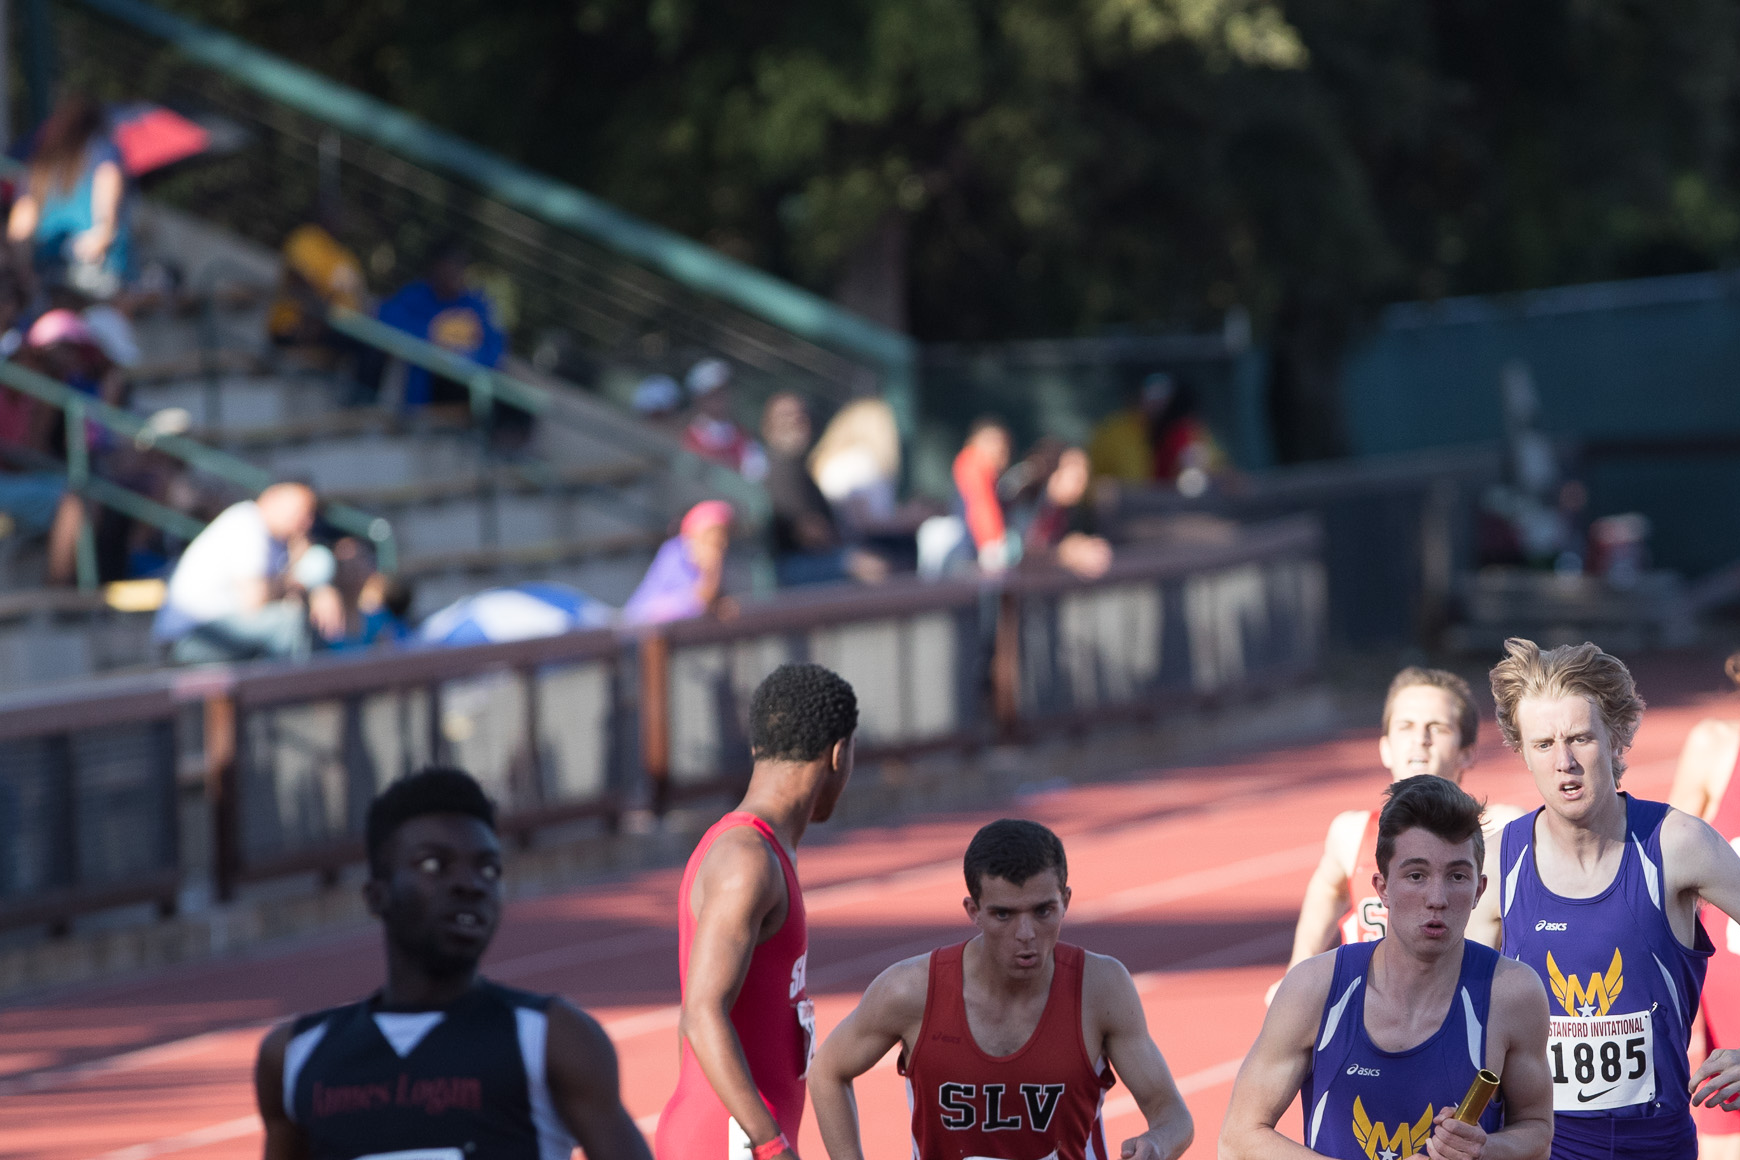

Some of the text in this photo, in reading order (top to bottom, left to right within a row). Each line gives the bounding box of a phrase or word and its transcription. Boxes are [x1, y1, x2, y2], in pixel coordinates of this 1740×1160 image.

[1545, 922, 1567, 931] asics
[1549, 1017, 1644, 1038] STANFORD INVITATIONAL
[1357, 1065, 1381, 1077] asics
[1550, 1037, 1647, 1084] 1885
[939, 1082, 1065, 1132] SLV
